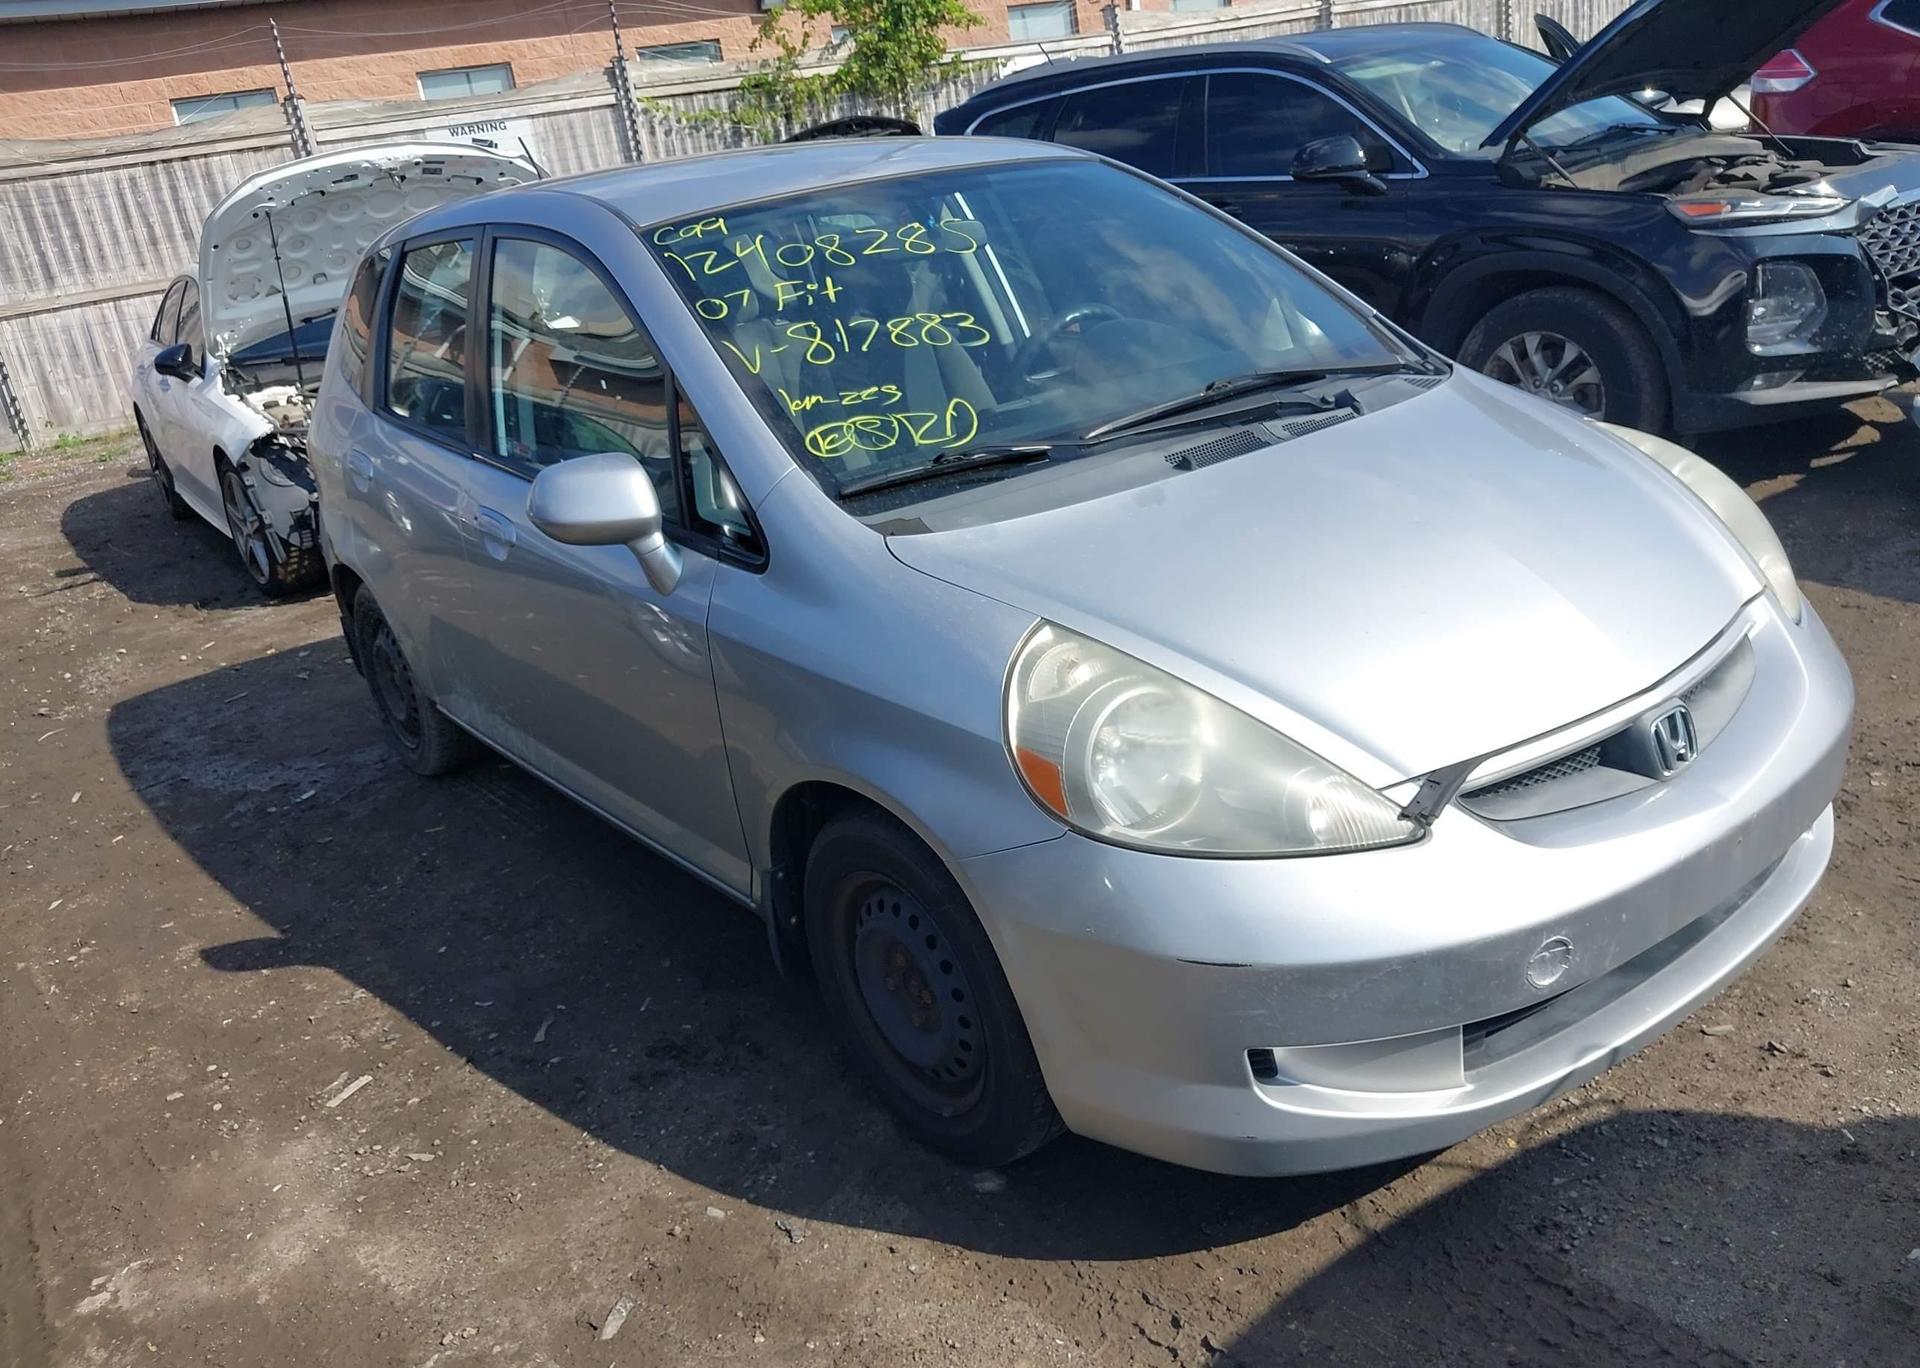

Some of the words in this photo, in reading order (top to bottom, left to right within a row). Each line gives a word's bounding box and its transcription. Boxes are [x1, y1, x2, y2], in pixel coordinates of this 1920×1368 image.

[450, 121, 507, 137] WARNING
[695, 289, 751, 320] 07
[774, 276, 843, 311] Fit
